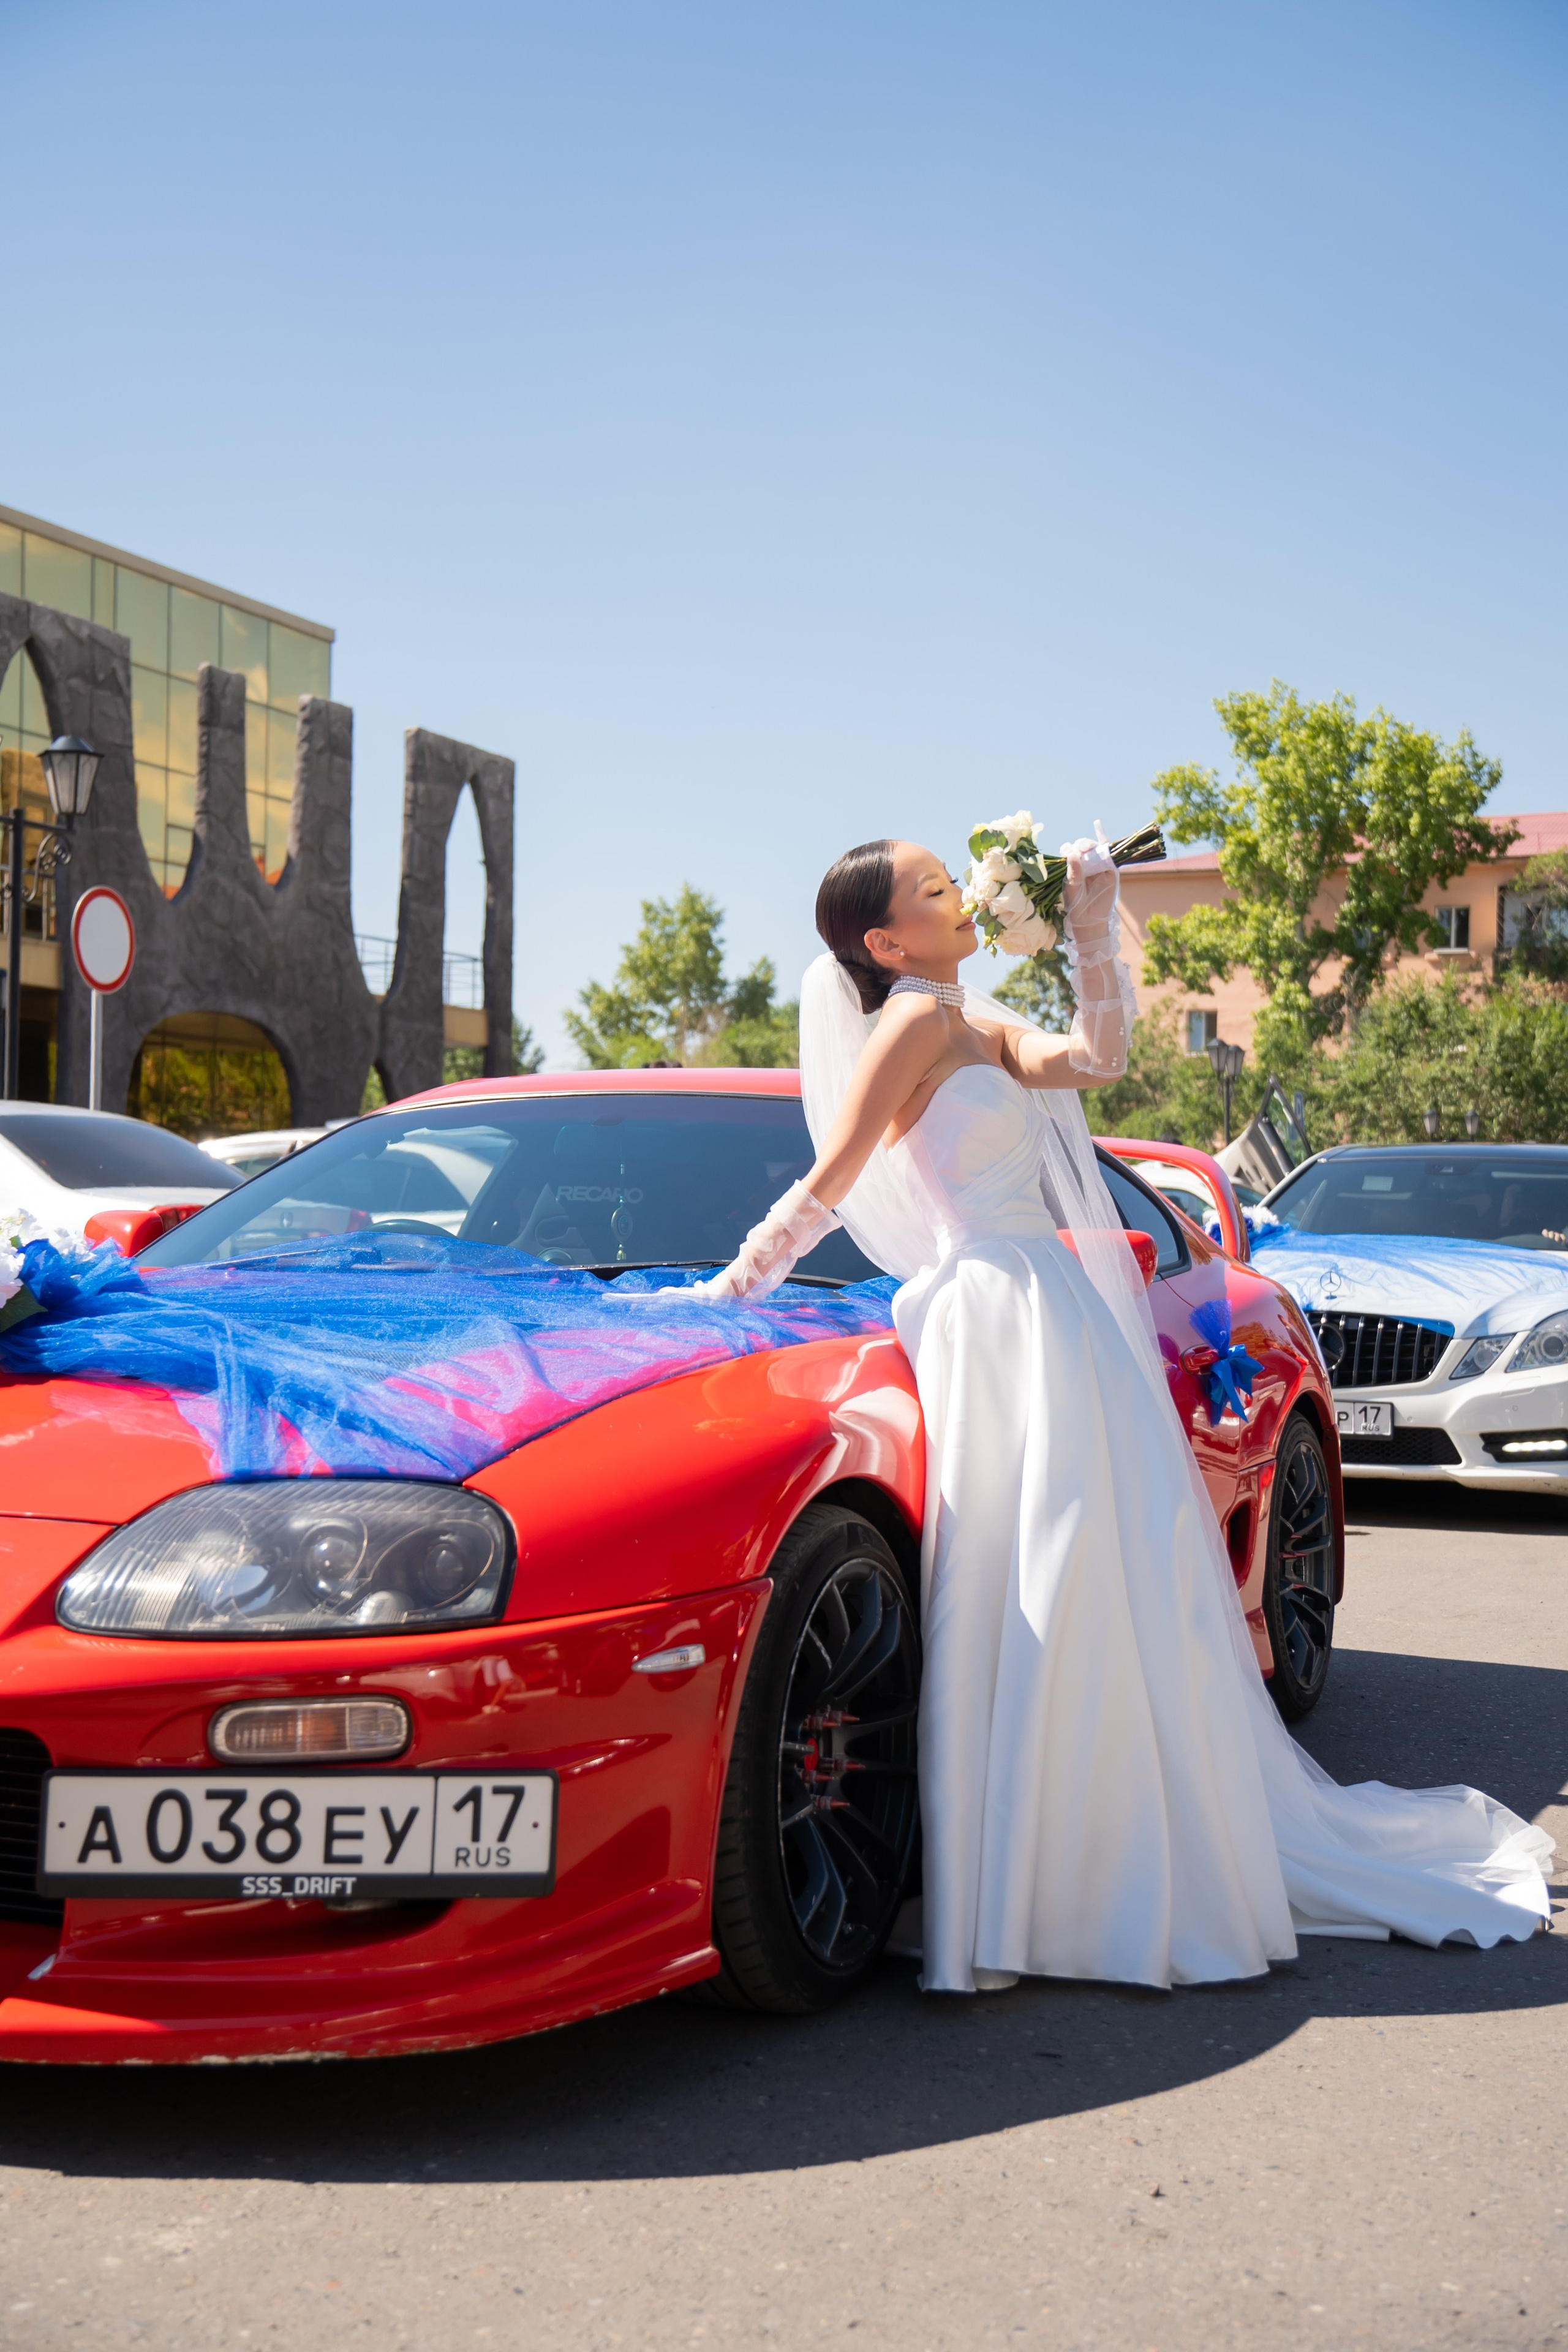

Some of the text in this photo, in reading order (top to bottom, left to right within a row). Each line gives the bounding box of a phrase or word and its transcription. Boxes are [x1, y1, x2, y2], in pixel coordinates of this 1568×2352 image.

[1358, 1406, 1381, 1423] 17
[452, 1785, 526, 1843] 17
[454, 1847, 512, 1868] RUS
[241, 1876, 357, 1896] SSS_DRIFT
